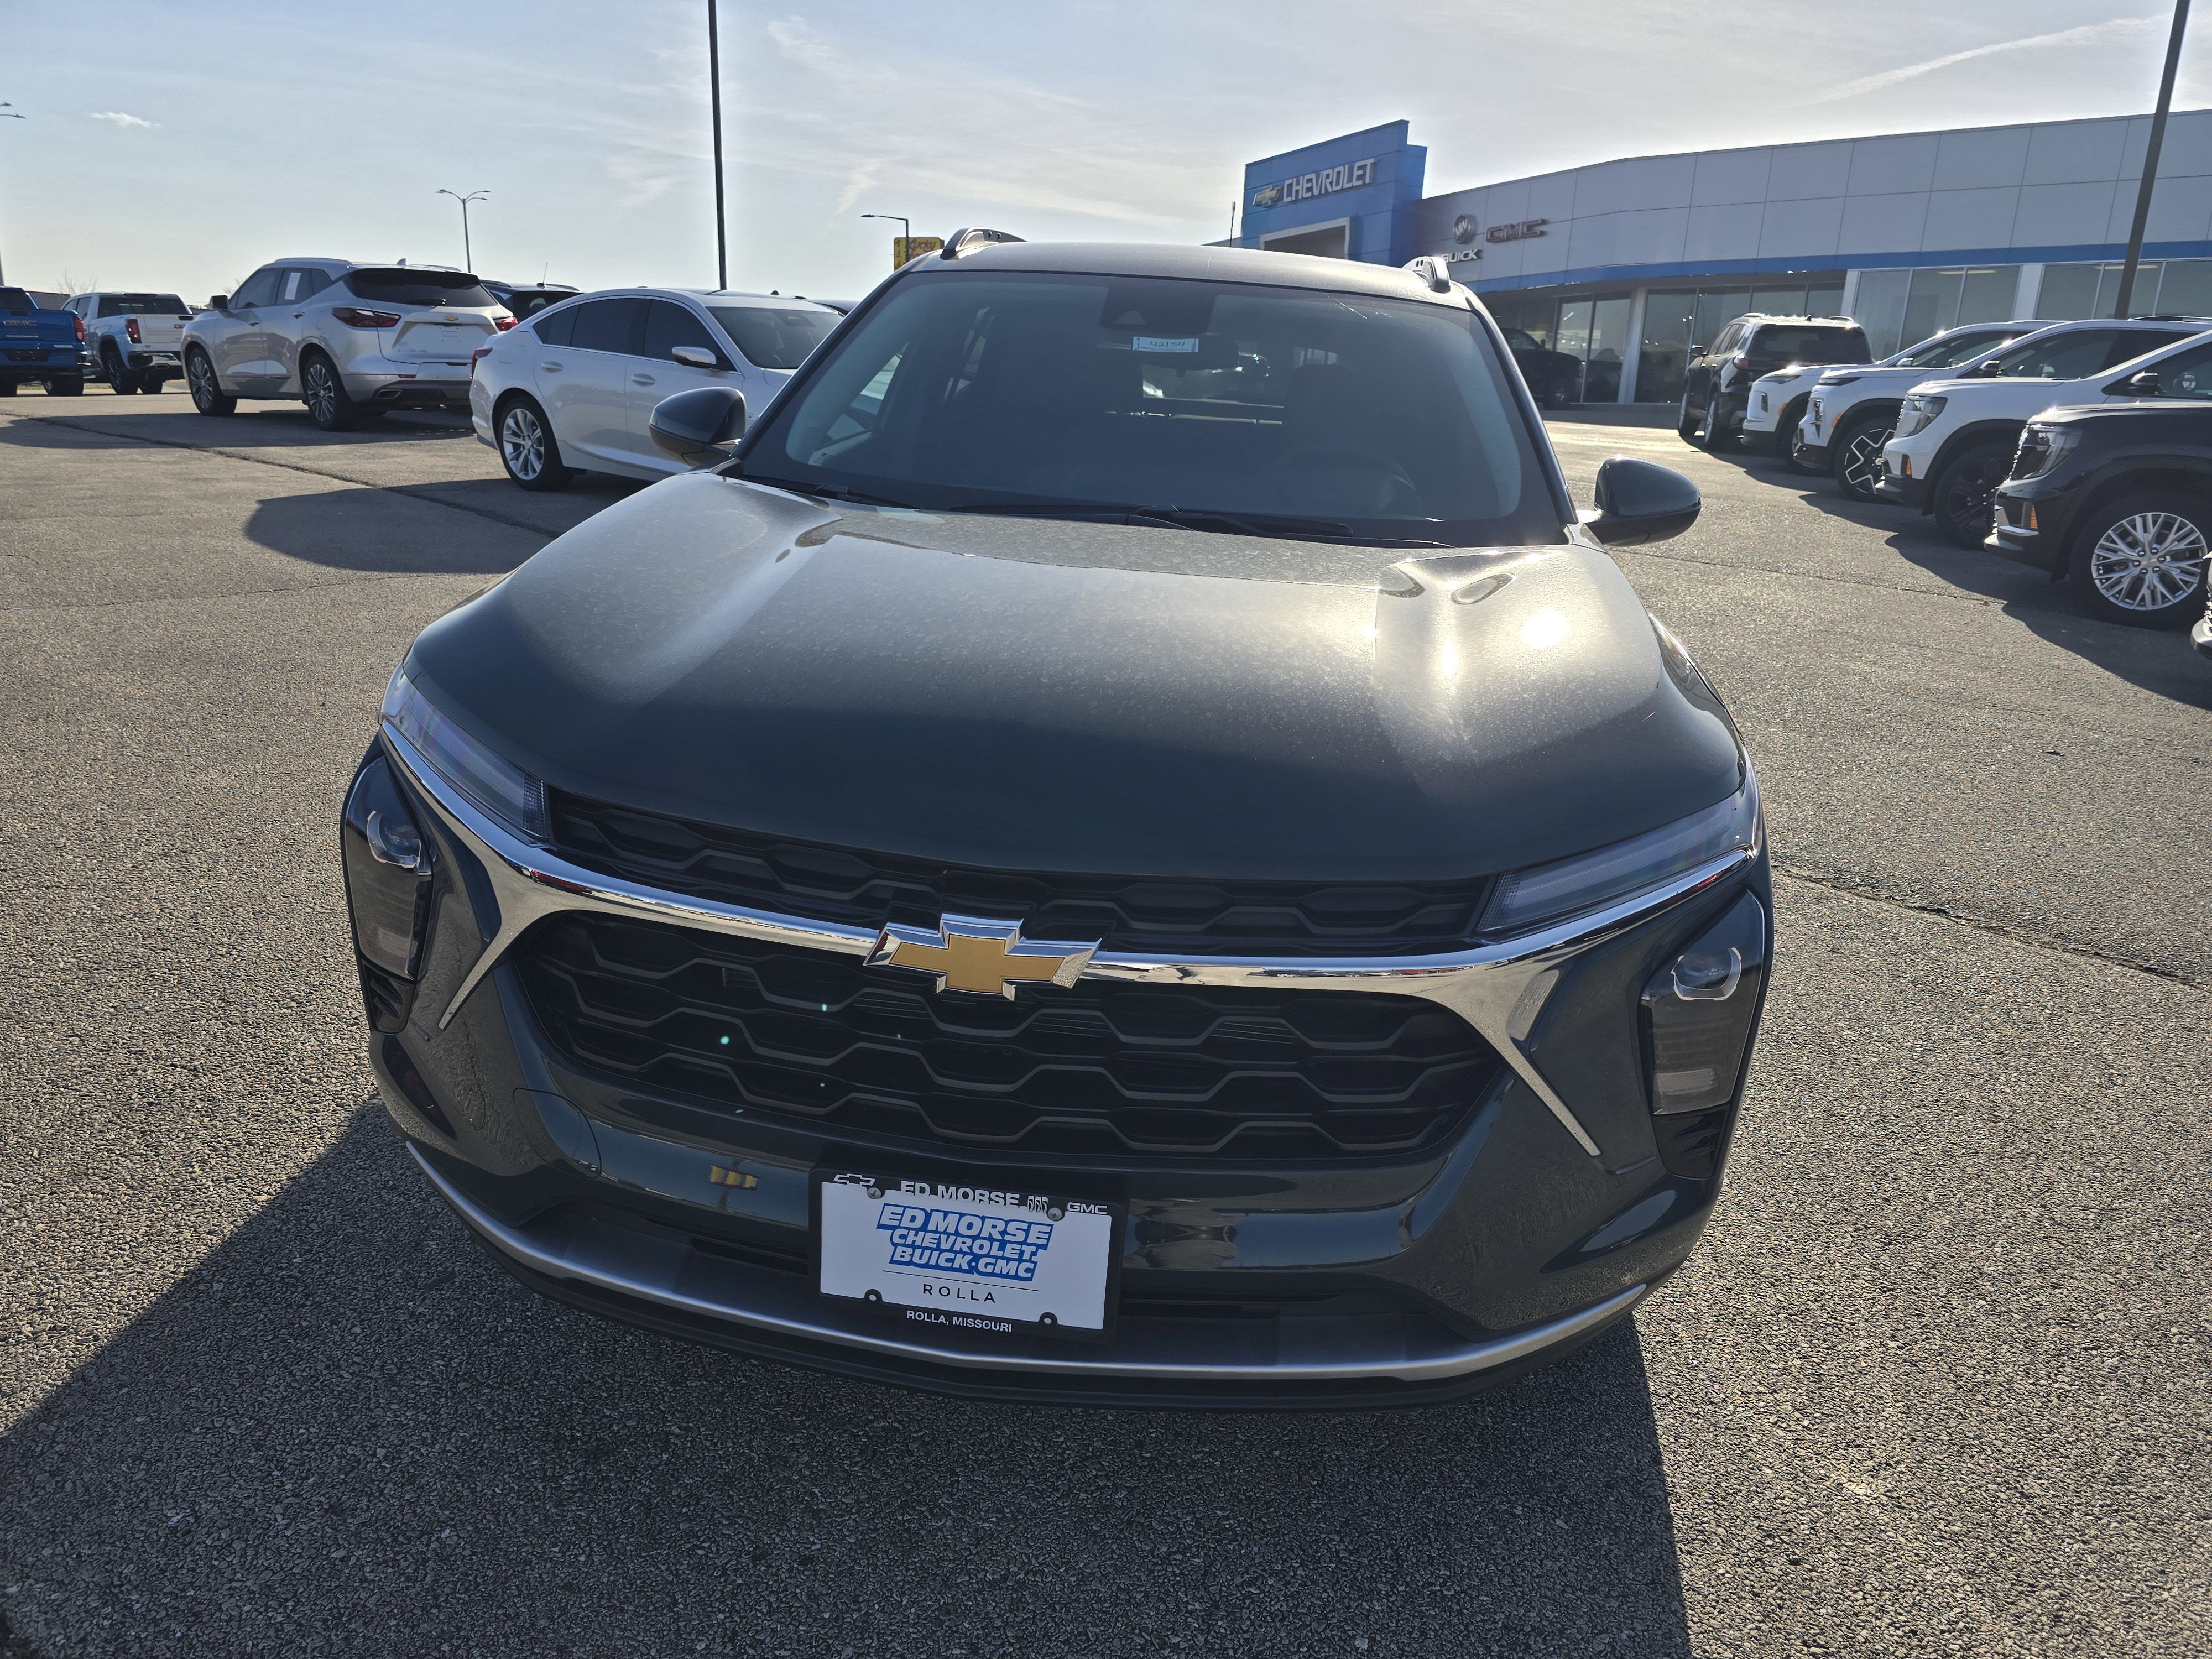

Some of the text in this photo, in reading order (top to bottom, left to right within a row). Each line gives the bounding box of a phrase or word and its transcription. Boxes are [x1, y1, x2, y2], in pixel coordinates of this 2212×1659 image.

[1283, 158, 1375, 202] CHEVROLET
[1486, 219, 1542, 243] GMC
[901, 1180, 1020, 1208] ED MORSE
[1067, 1202, 1108, 1215] GMC
[879, 1205, 1052, 1245] ED MORSE
[892, 1228, 1037, 1260] CHEVROLET
[922, 1284, 996, 1303] ROLLA
[906, 1310, 1012, 1333] ROLLA, MISSOURI
